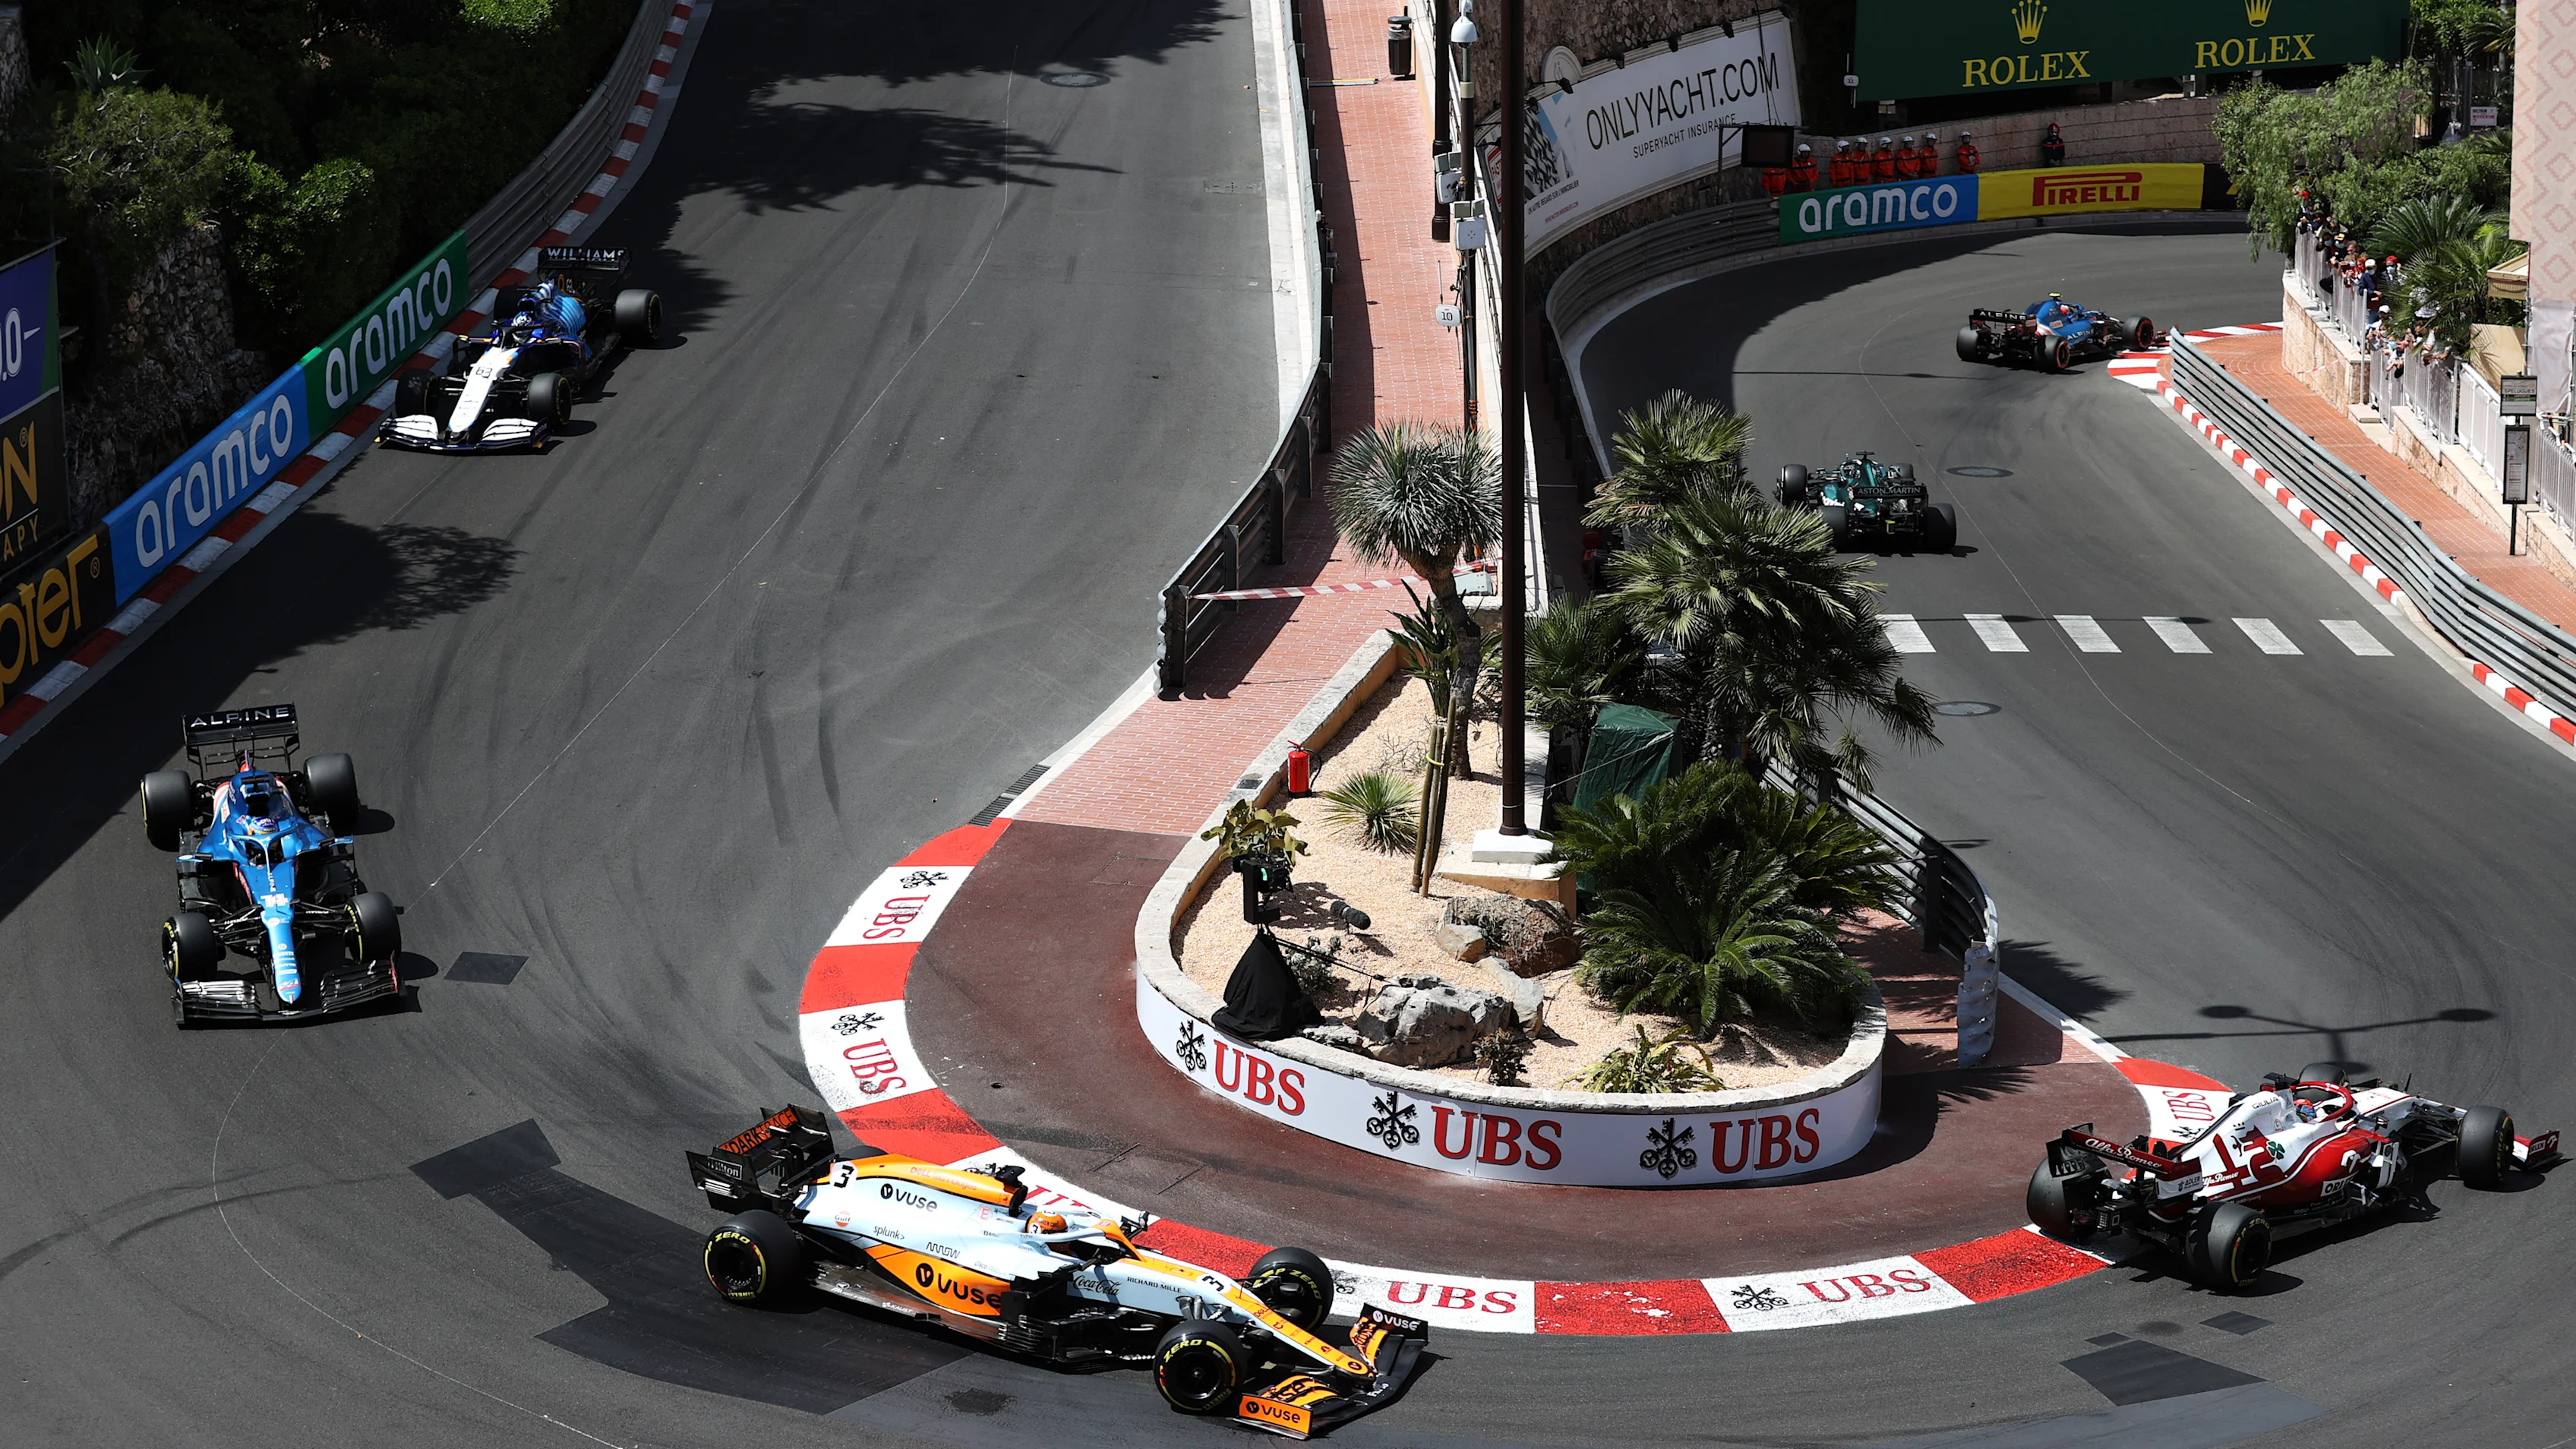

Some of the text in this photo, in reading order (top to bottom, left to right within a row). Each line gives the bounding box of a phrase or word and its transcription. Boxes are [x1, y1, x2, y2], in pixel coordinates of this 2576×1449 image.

[2195, 33, 2316, 69] ROLEX
[1962, 50, 2091, 87] ROLEX
[1586, 52, 1779, 150] ONLYYACHT.COM
[1634, 113, 1736, 159] SUPERYACHT INSURANCE
[2032, 172, 2142, 207] PIRELLI
[1798, 184, 1958, 233] aramco
[1441, 311, 1453, 321] 10
[1979, 311, 2026, 320] ALPINE
[325, 258, 452, 410] aramco
[2066, 328, 2095, 341] ALPINE
[475, 367, 493, 378] 63
[135, 394, 293, 568] aramco
[1857, 486, 1921, 495] ASTON MARTIN
[191, 707, 289, 728] ALPINE
[863, 894, 931, 940] UBS
[843, 1037, 907, 1094] UBS
[1214, 1038, 1305, 1117] UBS
[2162, 1091, 2216, 1121] UBS
[2252, 1096, 2279, 1109] GIULIA
[1431, 1105, 1561, 1170] UBS
[1709, 1108, 1820, 1174] UBS
[2085, 1138, 2163, 1168] Alfa Romeo
[708, 1160, 739, 1177] Hilton
[834, 1165, 854, 1189] 3
[909, 1166, 977, 1191] DELL Technologies
[2202, 1176, 2217, 1187] lfa
[2215, 1171, 2239, 1182] Romeo
[2185, 1176, 2201, 1187] ADLER
[873, 1225, 906, 1241] splunk>
[2249, 1217, 2270, 1230] ZERO
[715, 1231, 751, 1244] ZERO
[1127, 1277, 1182, 1293] RICHARD MILLE
[1201, 1275, 1225, 1292] 3
[1275, 1267, 1322, 1299] P ZERO
[1797, 1269, 1931, 1302] UBS
[890, 1303, 913, 1314] KAUST
[1387, 1280, 1517, 1314] UBS
[1163, 1339, 1203, 1363] ZERO
